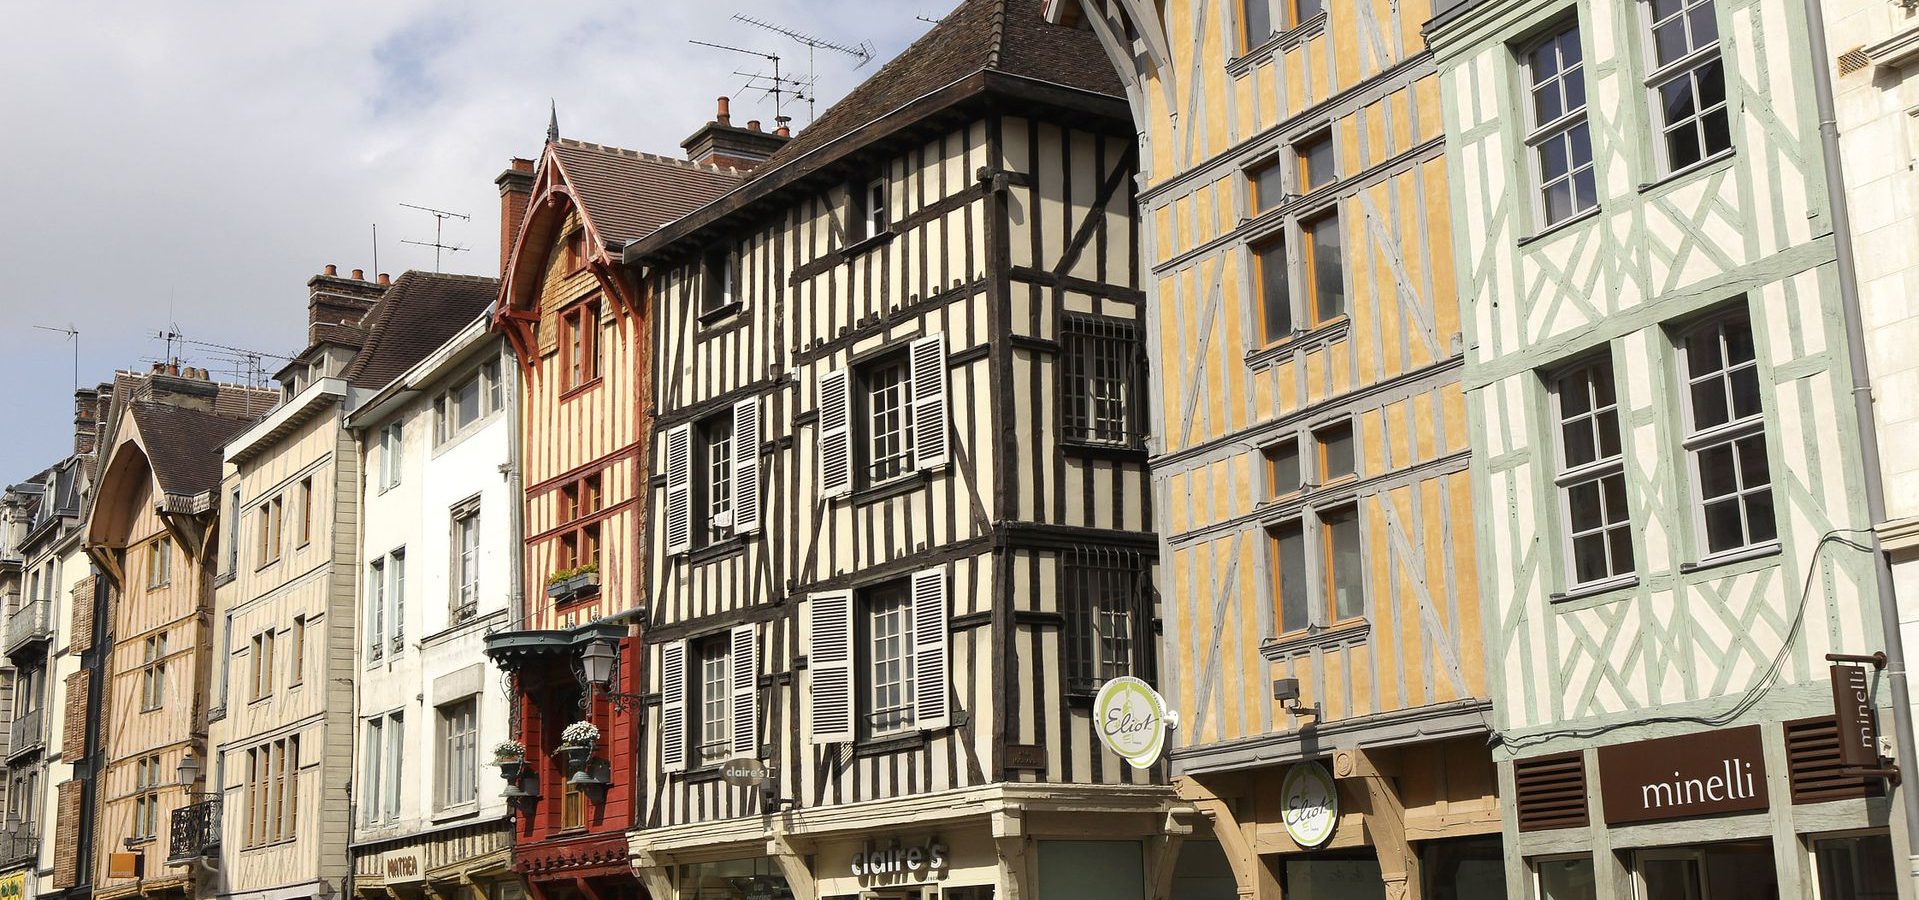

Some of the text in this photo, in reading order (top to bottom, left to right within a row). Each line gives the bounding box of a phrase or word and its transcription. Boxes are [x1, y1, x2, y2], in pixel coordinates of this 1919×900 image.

[1104, 708, 1159, 735] Eliot
[1850, 671, 1872, 748] minelli
[726, 766, 765, 777] claire's
[1641, 758, 1755, 809] minelli
[1286, 795, 1333, 825] Eliot
[387, 855, 418, 878] MATHEA
[851, 837, 942, 876] claire's
